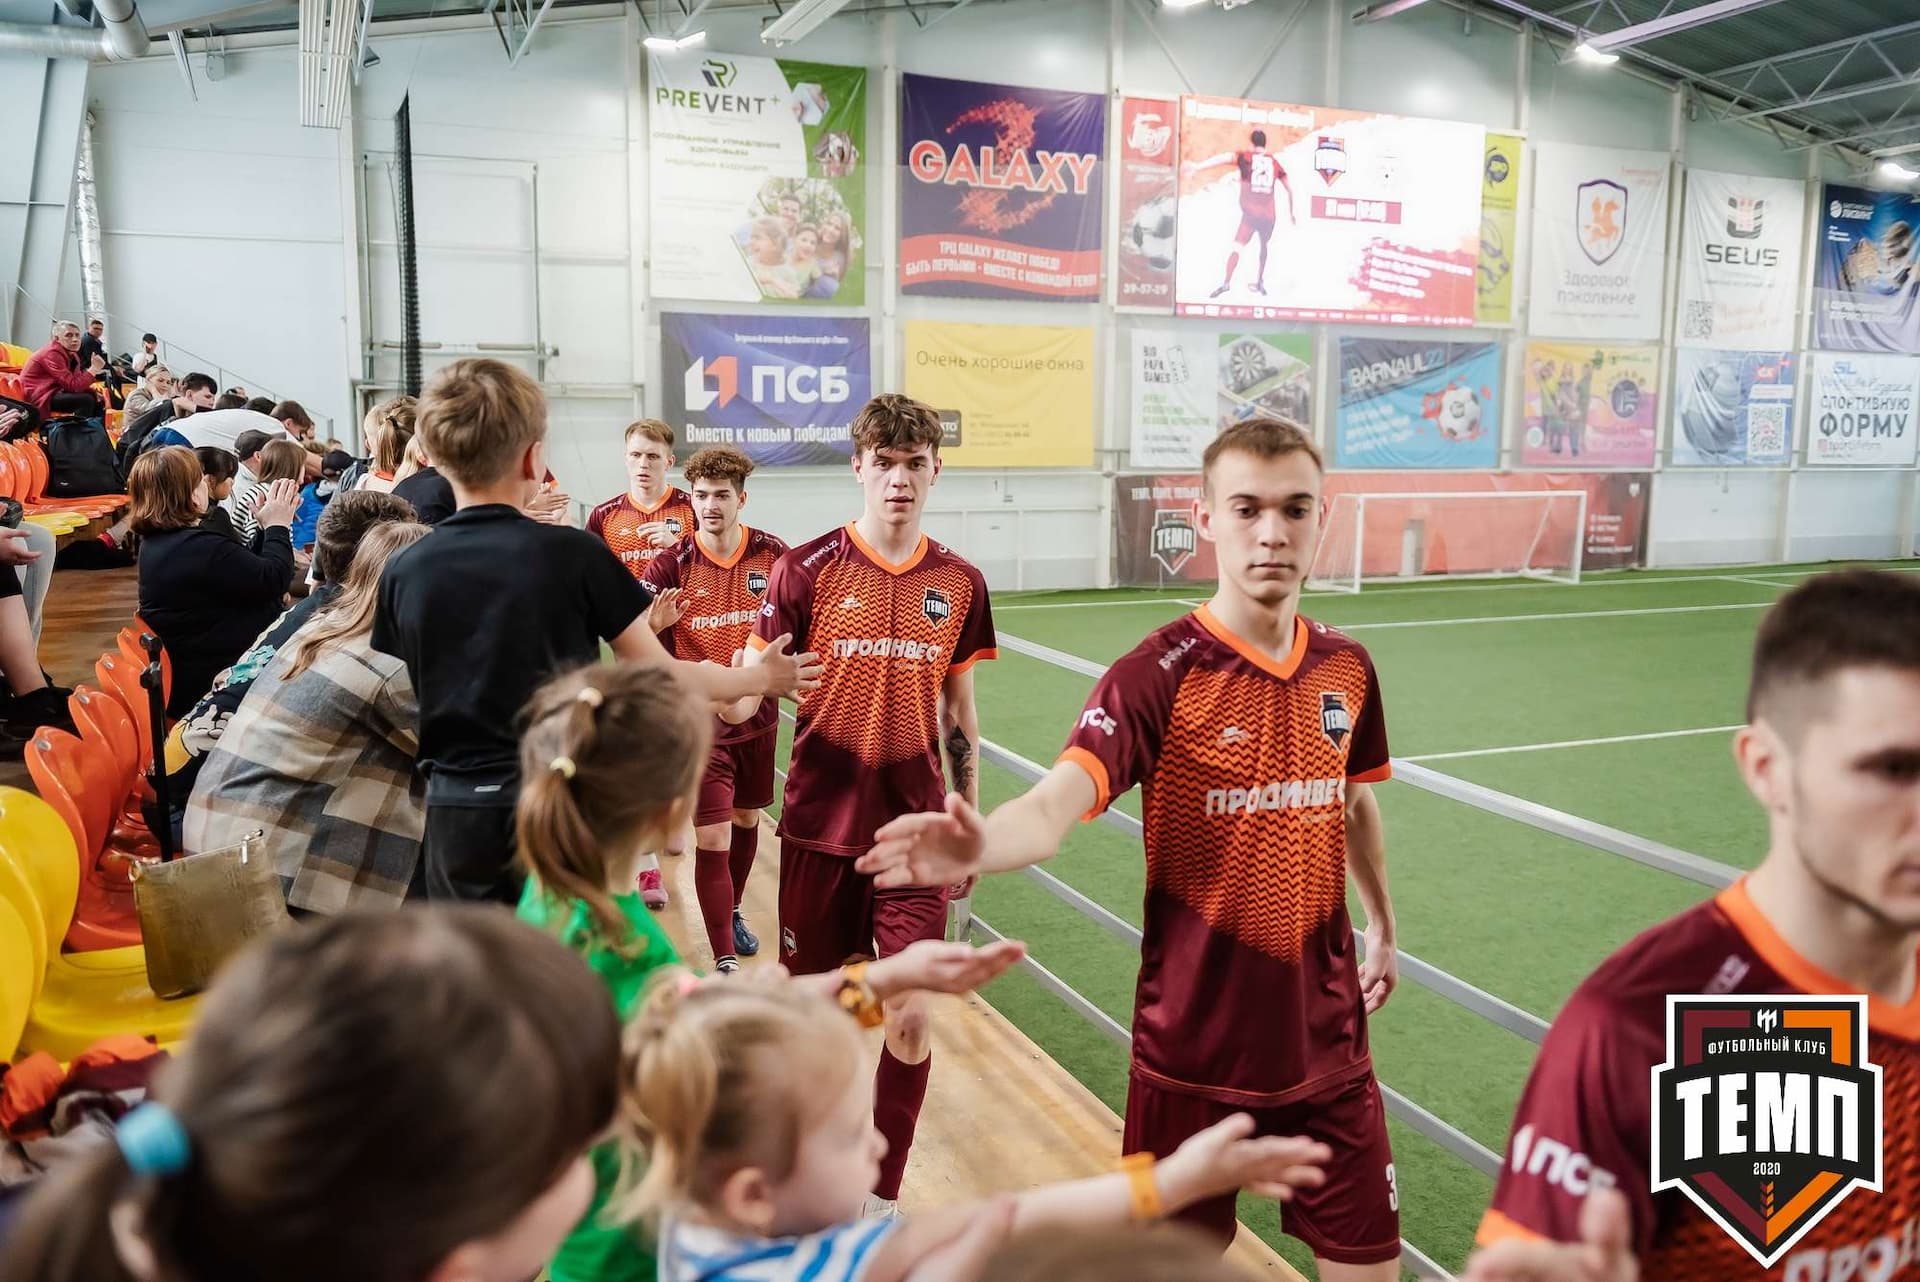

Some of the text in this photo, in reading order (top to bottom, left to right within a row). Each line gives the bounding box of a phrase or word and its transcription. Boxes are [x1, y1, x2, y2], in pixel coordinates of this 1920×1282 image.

[909, 140, 1097, 194] GALAXY
[1705, 243, 1780, 267] SEUS
[916, 350, 1084, 373] Очень хорошие окна
[752, 364, 850, 404] ПСБ
[686, 423, 851, 444] Вместе к новым победам!
[1819, 412, 1908, 438] ФОРМУ
[1156, 527, 1193, 551] ТЕМП
[926, 599, 949, 617] ТЕМП
[1385, 1162, 1399, 1212] 3
